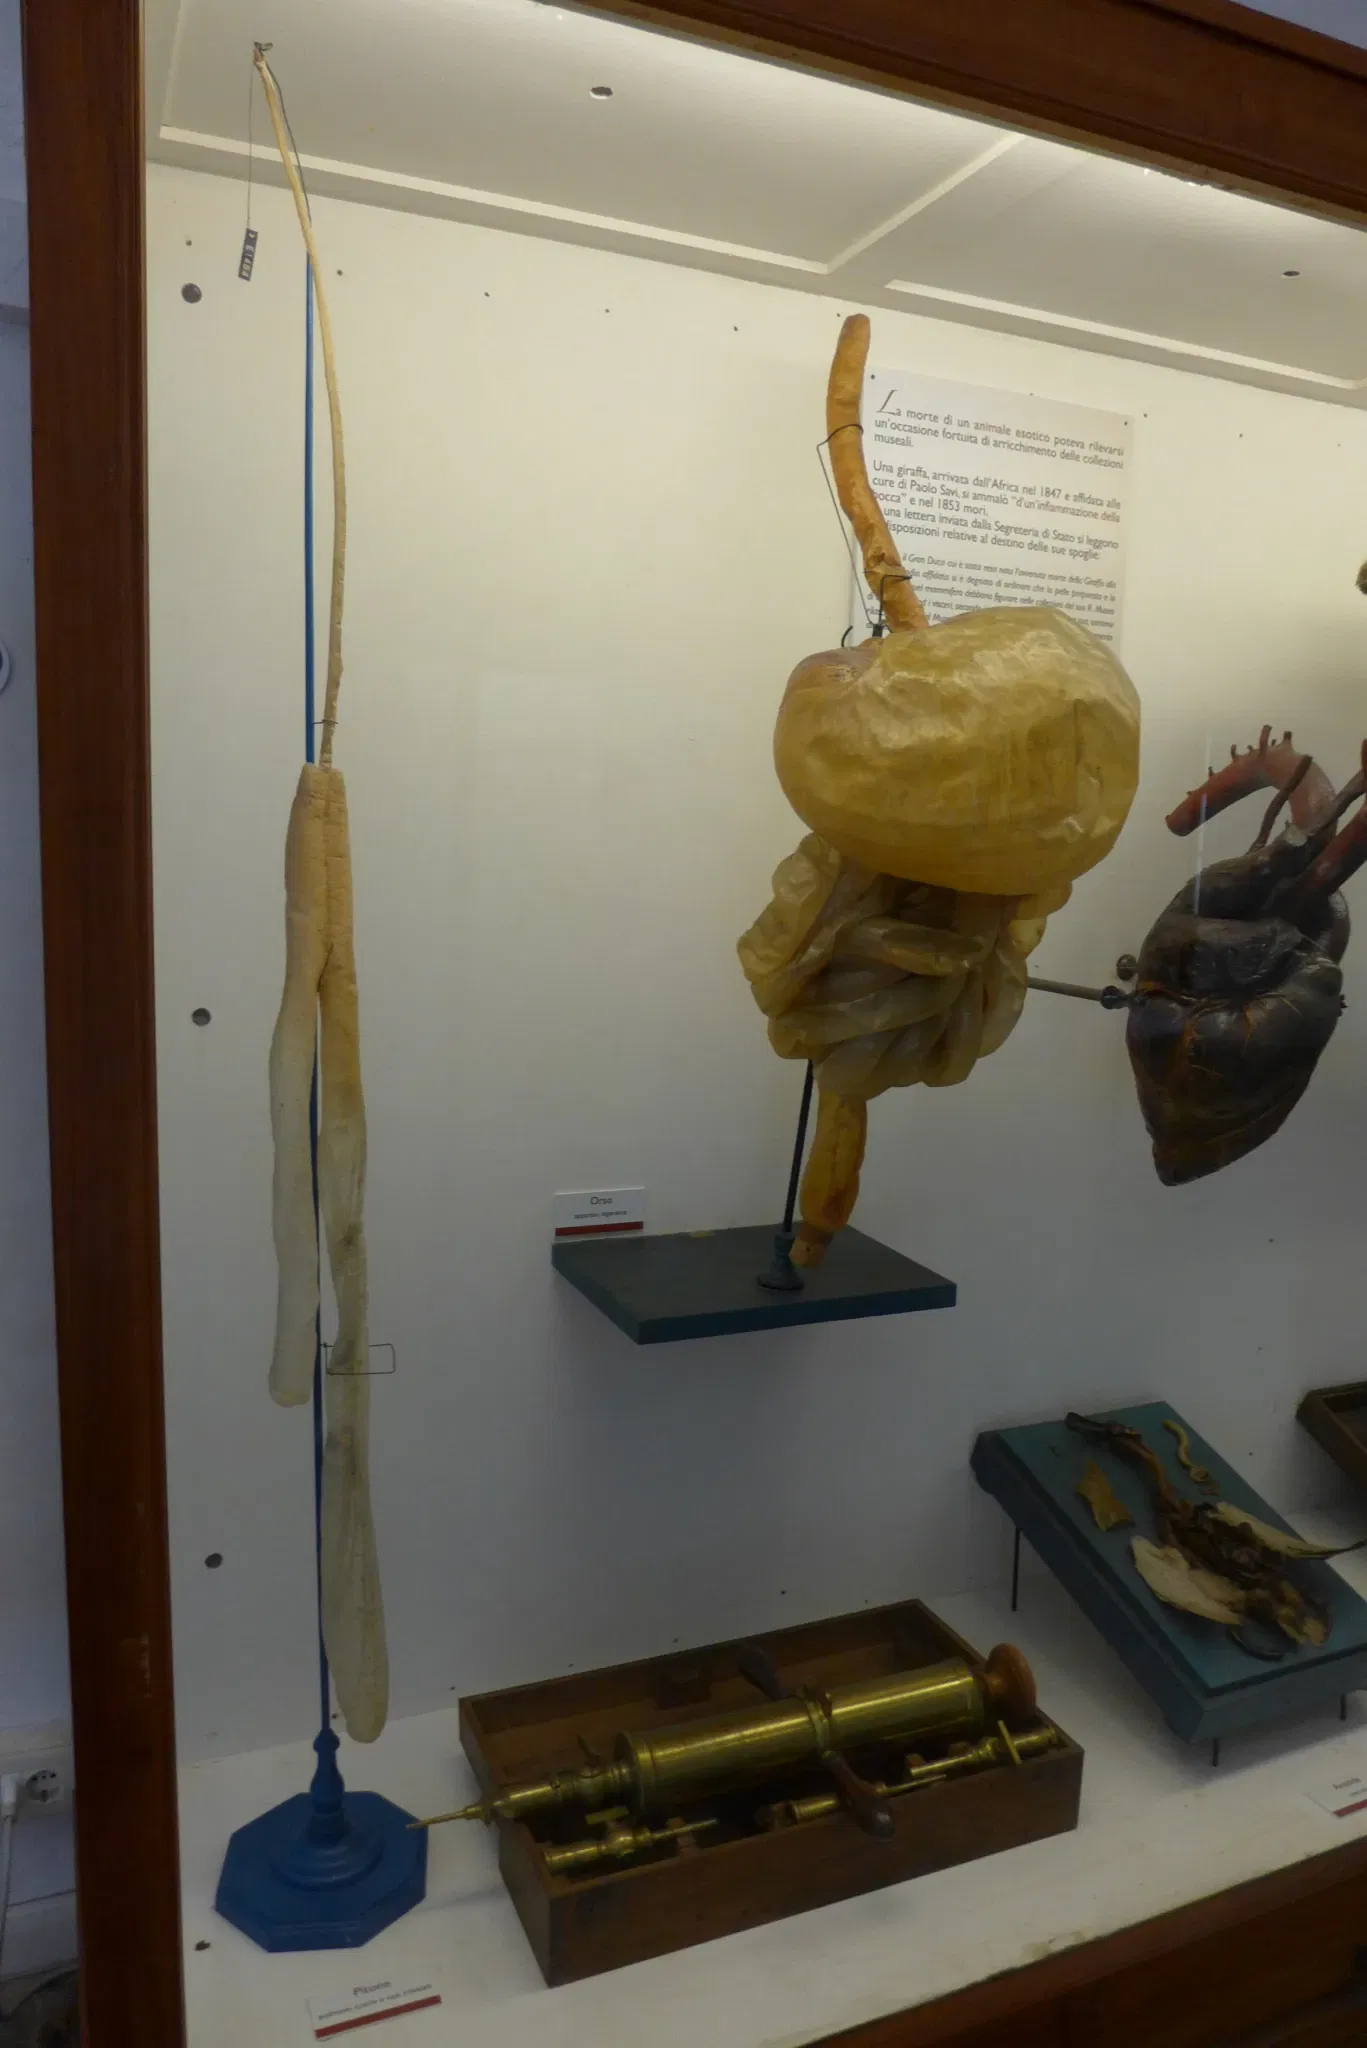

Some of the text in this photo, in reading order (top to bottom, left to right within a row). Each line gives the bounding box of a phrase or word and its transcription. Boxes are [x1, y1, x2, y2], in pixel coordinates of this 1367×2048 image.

[874, 434, 914, 448] museali.
[875, 418, 1124, 469] un'occasione fortuita di arricchimento delle collezioni
[876, 389, 1124, 456] La morte di un animale esotico poteva rilevarsi
[872, 478, 894, 488] cure
[898, 480, 907, 490] di
[910, 480, 938, 494] Paolo
[940, 484, 960, 499] Savi,
[962, 491, 970, 499] si
[1100, 512, 1120, 523] della
[873, 460, 894, 473] Una
[897, 465, 930, 480] giraffa,
[932, 472, 969, 485] arrivata
[972, 476, 1019, 493] dall'Africa
[1022, 485, 1036, 496] nel
[1040, 486, 1062, 499] 1847
[1072, 492, 1104, 506] affidata
[1106, 498, 1121, 510] alle
[910, 497, 916, 506] e
[918, 498, 934, 508] nel
[938, 498, 960, 512] 1853
[884, 508, 1119, 550] una lettera inviata dalla Segreteria di Stato si leggono
[943, 529, 977, 544] relative
[980, 534, 988, 544] al
[991, 535, 1024, 550] destino
[1028, 541, 1048, 552] delle
[1052, 545, 1066, 556] sue
[590, 1196, 612, 1205] Orso
